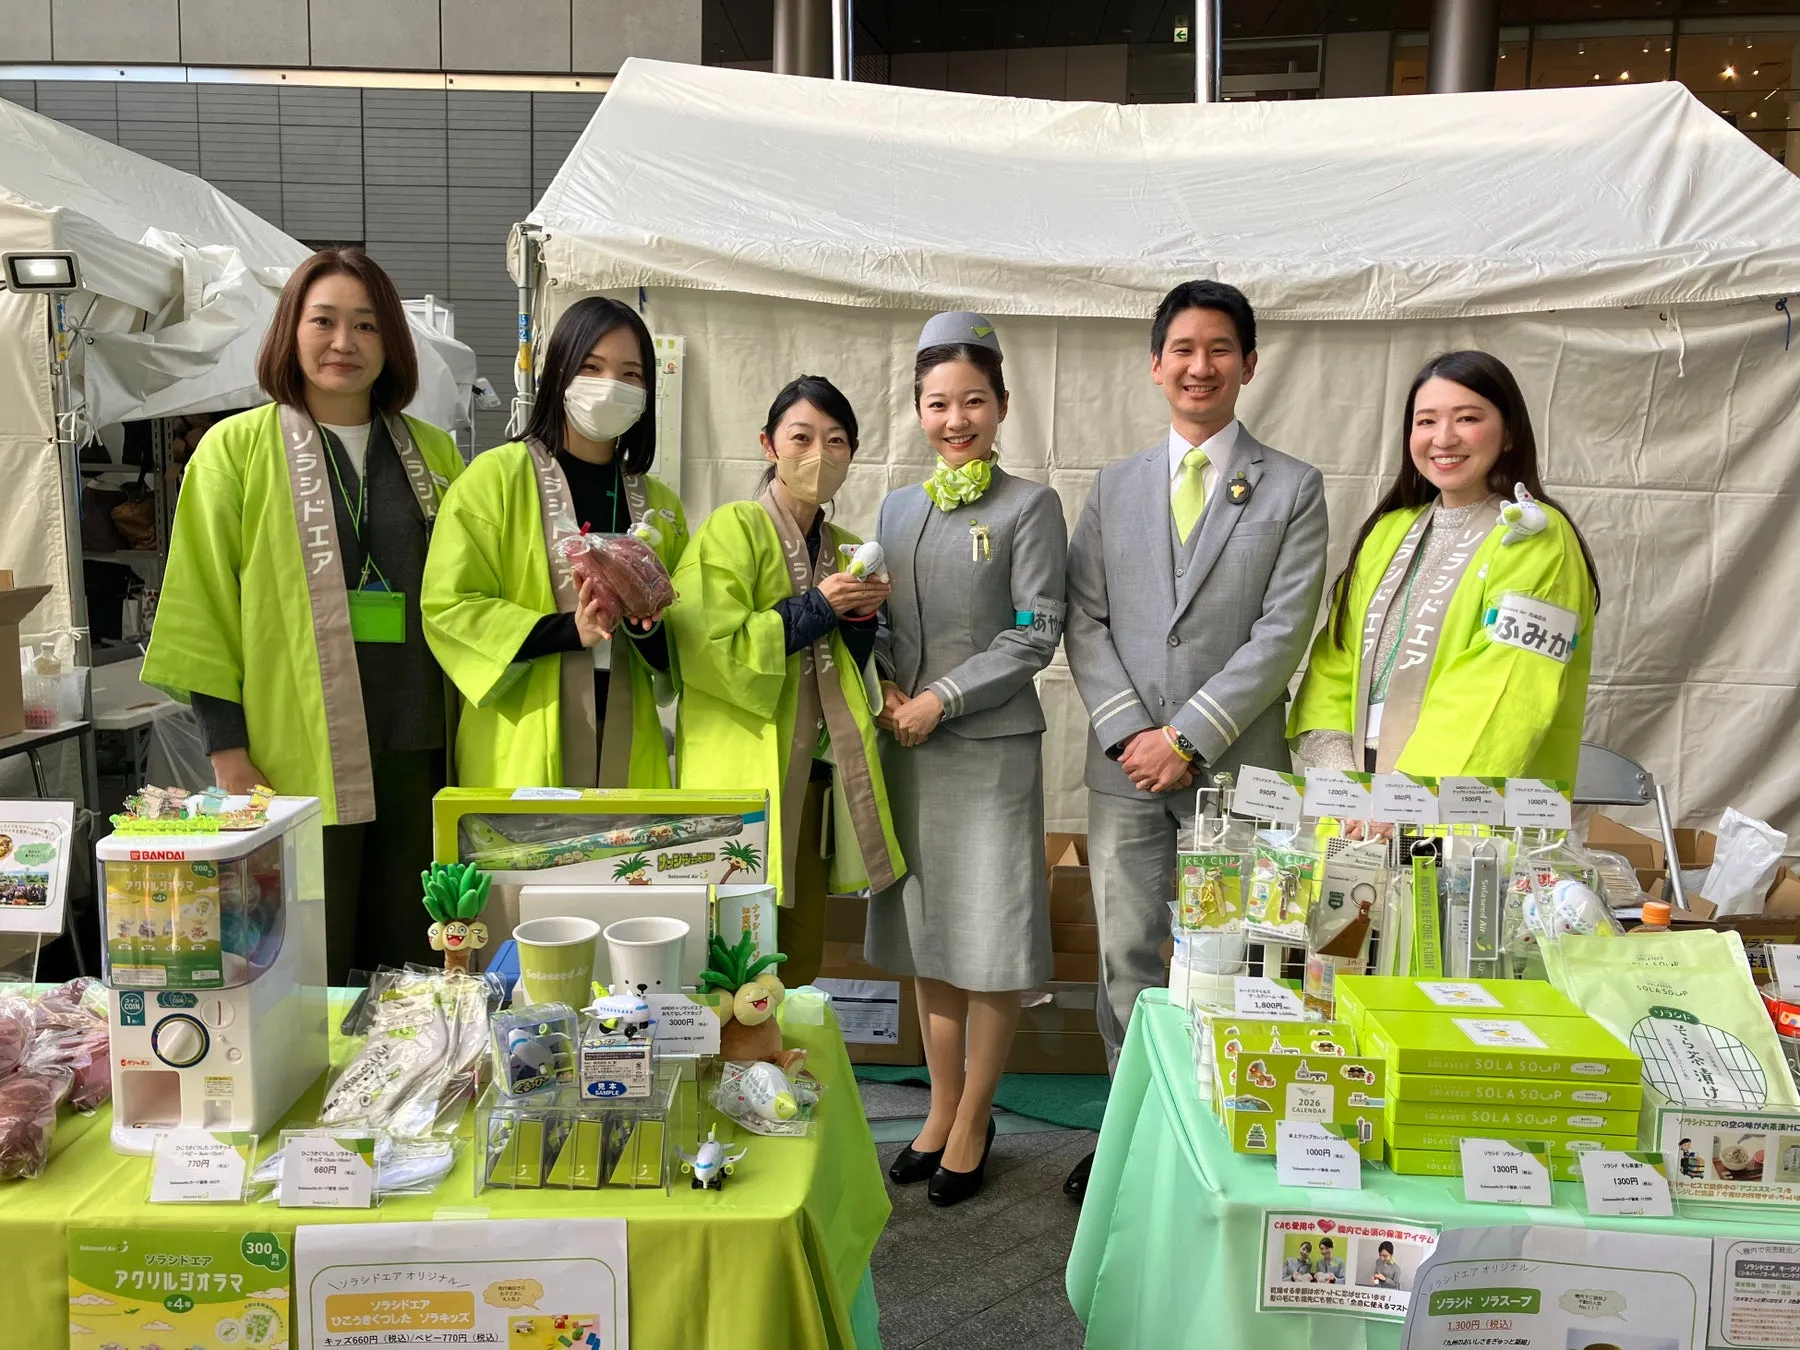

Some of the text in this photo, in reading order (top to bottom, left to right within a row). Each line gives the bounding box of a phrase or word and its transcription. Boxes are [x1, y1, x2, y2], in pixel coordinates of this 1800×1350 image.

[292, 430, 333, 575] ソラシドエア
[1397, 529, 1484, 670] ソラシドエア
[1495, 615, 1572, 658] ふみか
[142, 851, 185, 860] BANDAI
[1185, 856, 1235, 865] KEY CLIP
[1420, 876, 1435, 969] REMOVE BEFORE FLIGHT
[526, 967, 575, 980] Solaseed
[1255, 1001, 1282, 1010] 1,800円
[669, 1018, 694, 1026] 3000円
[1475, 1058, 1514, 1071] SOLA
[1673, 1024, 1719, 1099] そら茶漬け
[1476, 1086, 1515, 1099] SOLA
[1298, 1098, 1321, 1107] 2026
[1472, 1110, 1510, 1123] SOLA
[1306, 1148, 1331, 1157] 1000円
[187, 1159, 210, 1168] 770円
[313, 1165, 337, 1174] 660円
[1492, 1165, 1518, 1174] 1300円
[1613, 1177, 1639, 1185] 1300円
[1274, 1221, 1316, 1231] CAも愛用中
[1338, 1225, 1434, 1244] 機内で必須の保湿アイテム
[246, 1242, 273, 1255] 300
[145, 1254, 213, 1267] ソラシドエア
[271, 1253, 280, 1261] 円
[1482, 1263, 1529, 1274] オリジナル
[114, 1269, 244, 1293] アクリルジオラマ
[339, 1270, 459, 1289] ソラシドエア オリジナル
[370, 1299, 431, 1312] ソラシドエア
[1436, 1295, 1533, 1310] ソラシド ソラスープ
[330, 1312, 470, 1327] ひこうきくつした ソラキッズ
